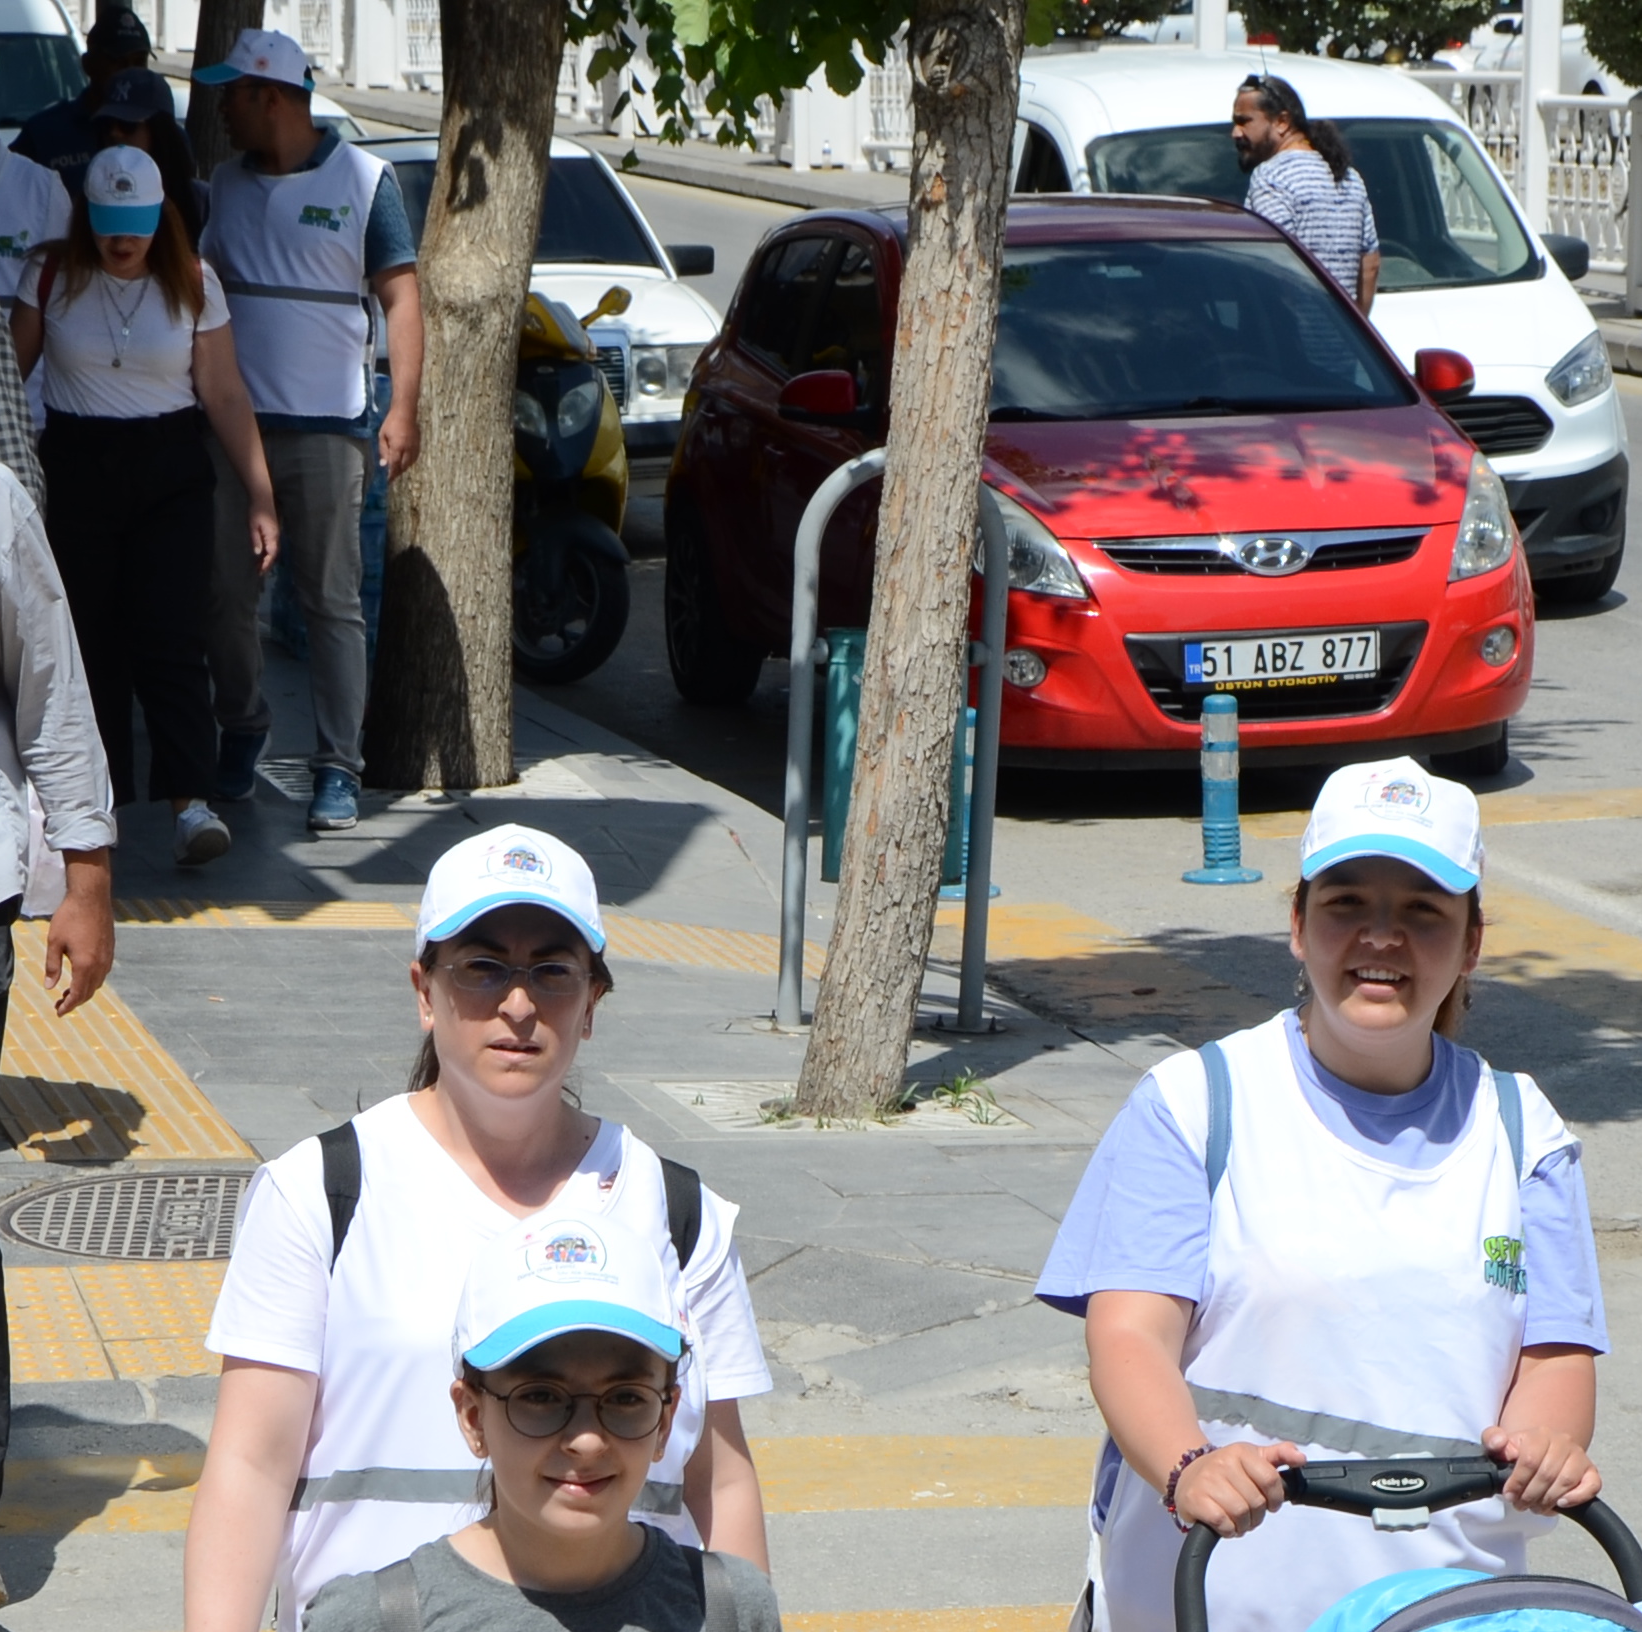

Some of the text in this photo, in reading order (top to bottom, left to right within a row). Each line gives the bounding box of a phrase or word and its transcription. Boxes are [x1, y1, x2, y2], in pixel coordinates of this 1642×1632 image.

[1202, 636, 1371, 677] 51 ABZ 877
[1267, 674, 1337, 688] OTOMOTİV
